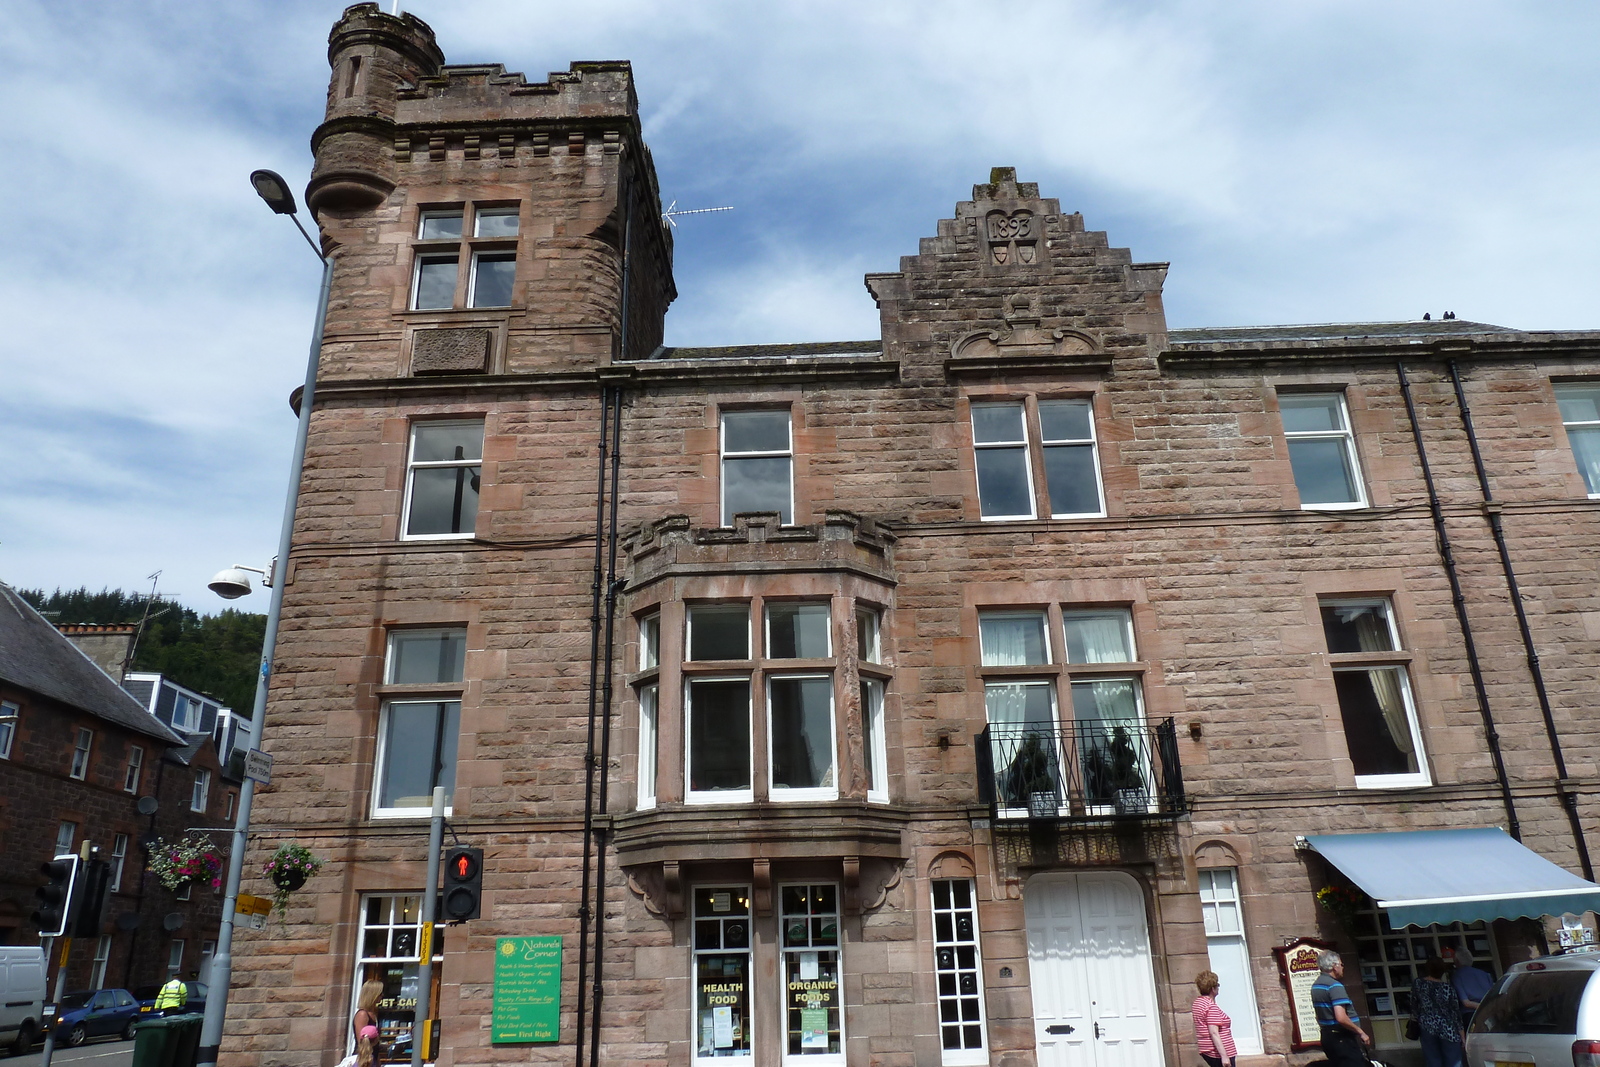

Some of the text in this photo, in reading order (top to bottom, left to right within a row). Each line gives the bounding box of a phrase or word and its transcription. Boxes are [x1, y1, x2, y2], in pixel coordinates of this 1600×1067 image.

[992, 217, 1031, 238] 1893
[524, 949, 558, 960] Corner
[703, 982, 743, 993] HEALTH
[788, 981, 837, 991] ORGANIC
[398, 998, 418, 1007] CAR
[709, 995, 738, 1005] FOOD
[795, 993, 830, 1003] FOODS
